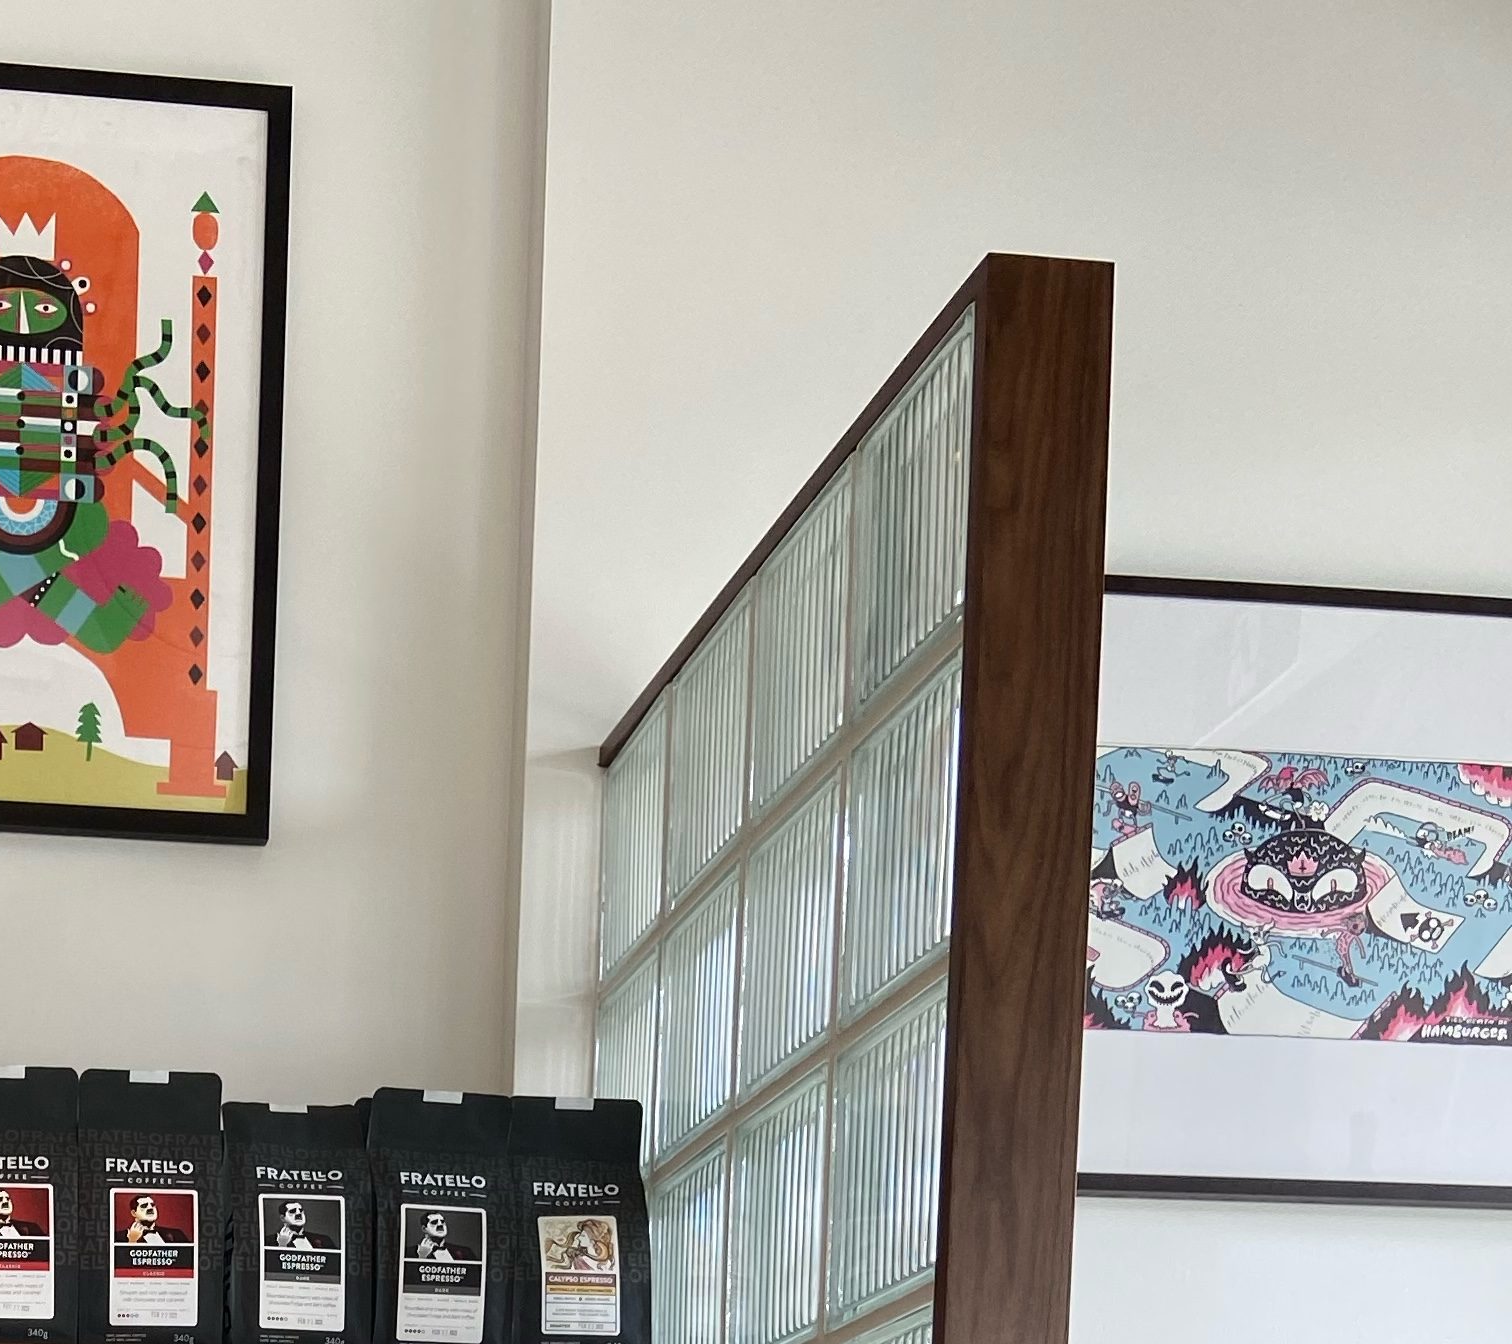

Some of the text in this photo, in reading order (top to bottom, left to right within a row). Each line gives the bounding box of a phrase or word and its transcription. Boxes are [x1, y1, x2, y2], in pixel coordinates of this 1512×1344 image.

[1421, 1024, 1508, 1041] HAMBURGER
[105, 1158, 194, 1175] FRATELLO
[255, 1166, 343, 1181] FRATELLO
[399, 1171, 486, 1189] FRATELLO
[423, 1189, 466, 1197] COFFEE
[533, 1182, 619, 1197] FRATELLO
[279, 1254, 326, 1263] GODFATHER
[419, 1266, 467, 1275] GODFATHER
[27, 1328, 48, 1340] 340g
[173, 1333, 194, 1344] 340g
